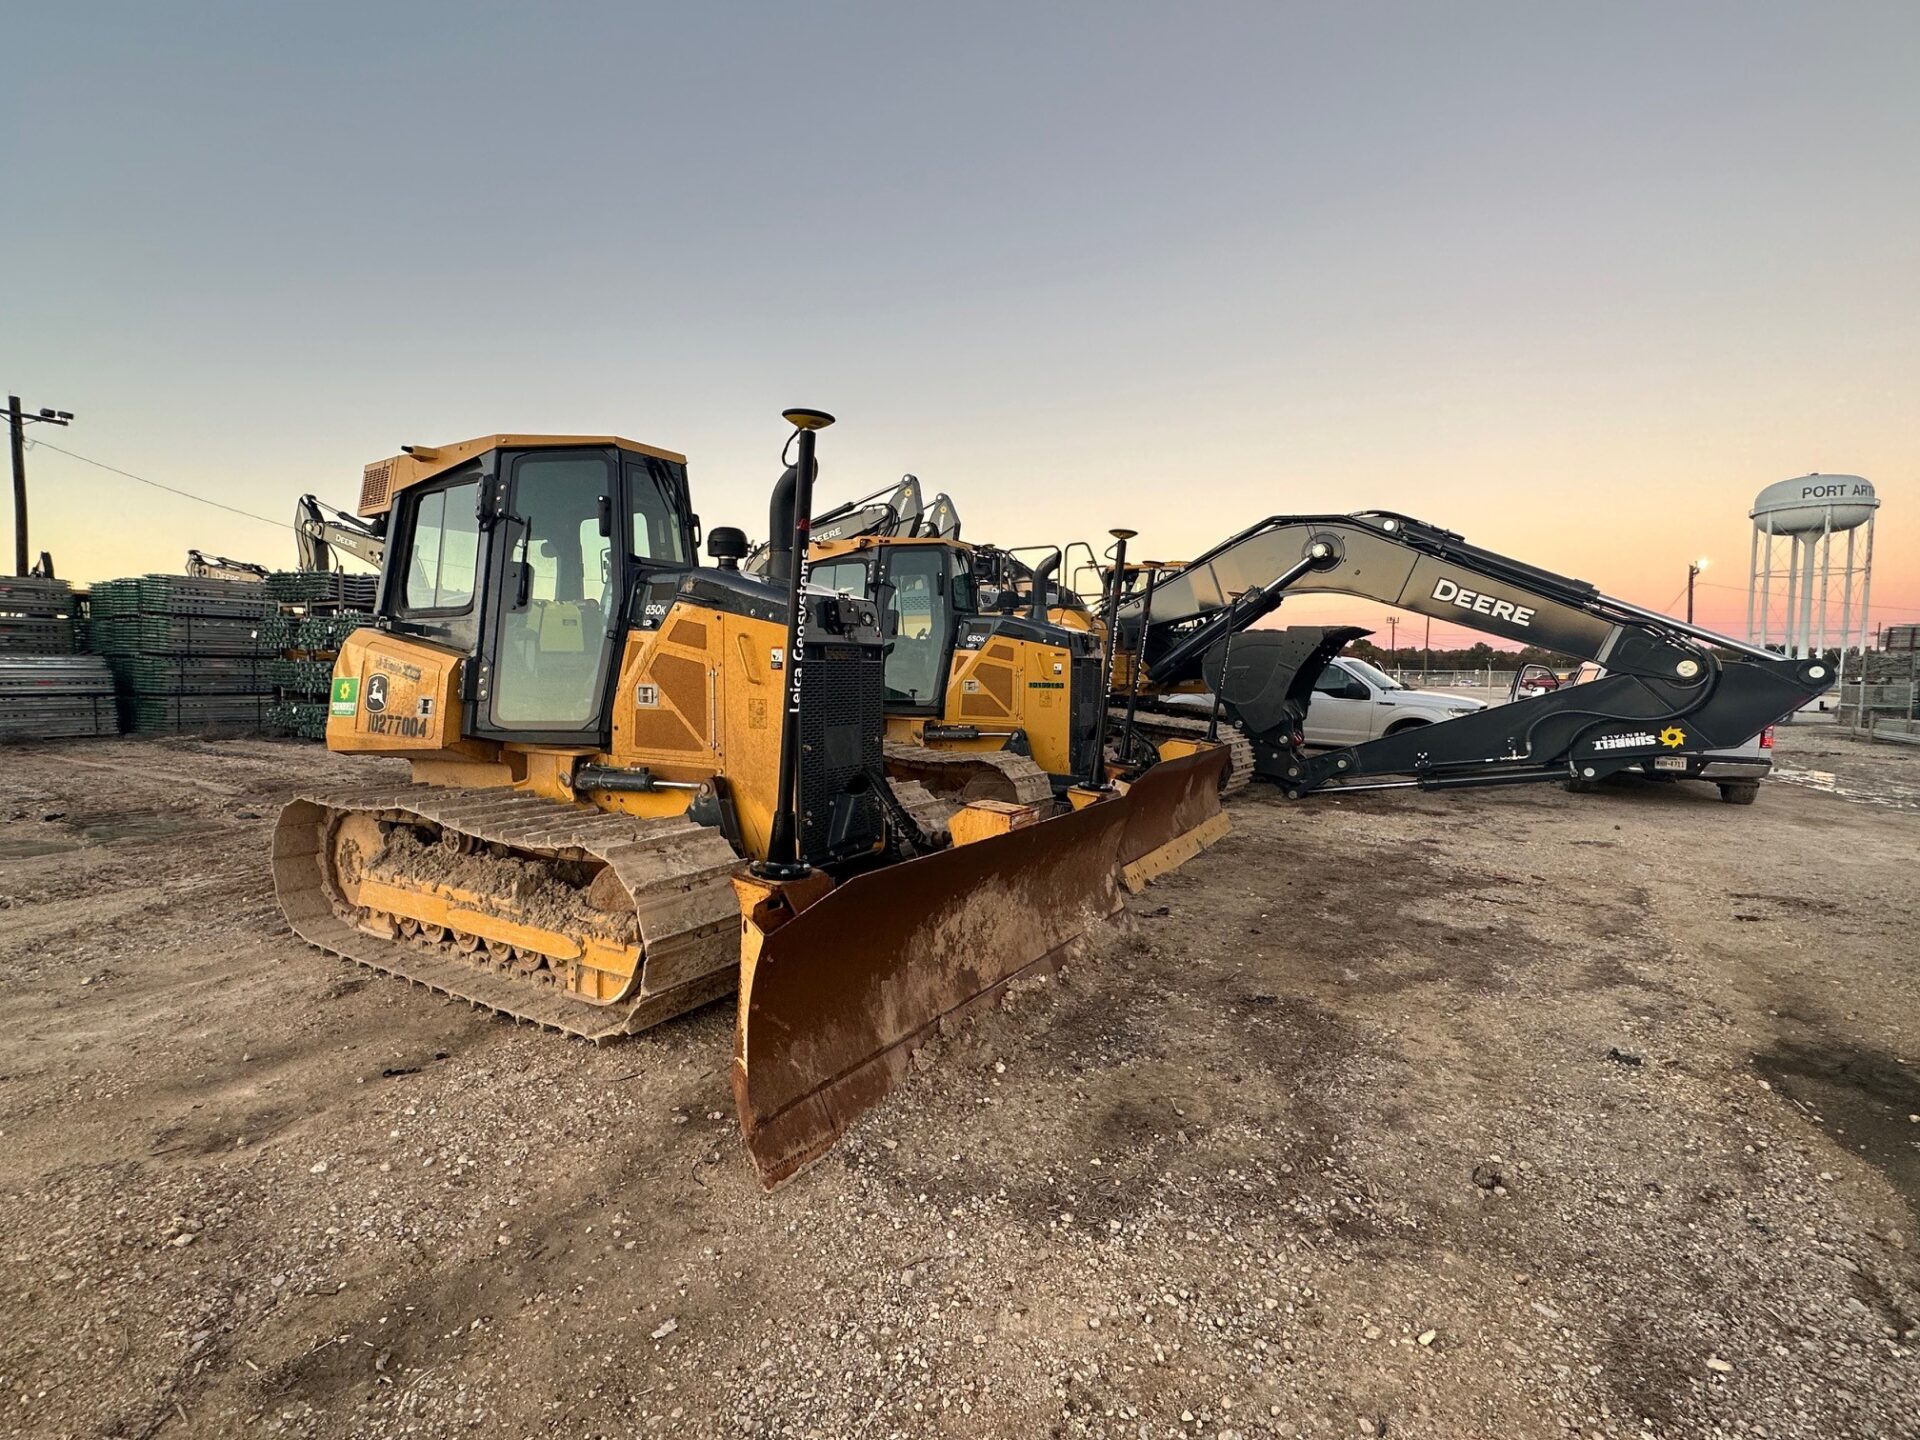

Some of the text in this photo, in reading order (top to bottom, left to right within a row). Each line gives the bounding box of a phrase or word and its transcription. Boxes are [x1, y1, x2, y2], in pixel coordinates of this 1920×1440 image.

[1802, 484, 1847, 499] PORT
[335, 533, 358, 549] DEERE
[645, 604, 667, 615] 650K
[792, 548, 810, 662] Geosystems
[1430, 577, 1537, 627] DEERE
[966, 634, 986, 643] 650K
[789, 667, 803, 713] Leica
[367, 714, 428, 738] 10277004
[1593, 735, 1656, 750] SUNBELT
[1601, 732, 1646, 740] RENTALS
